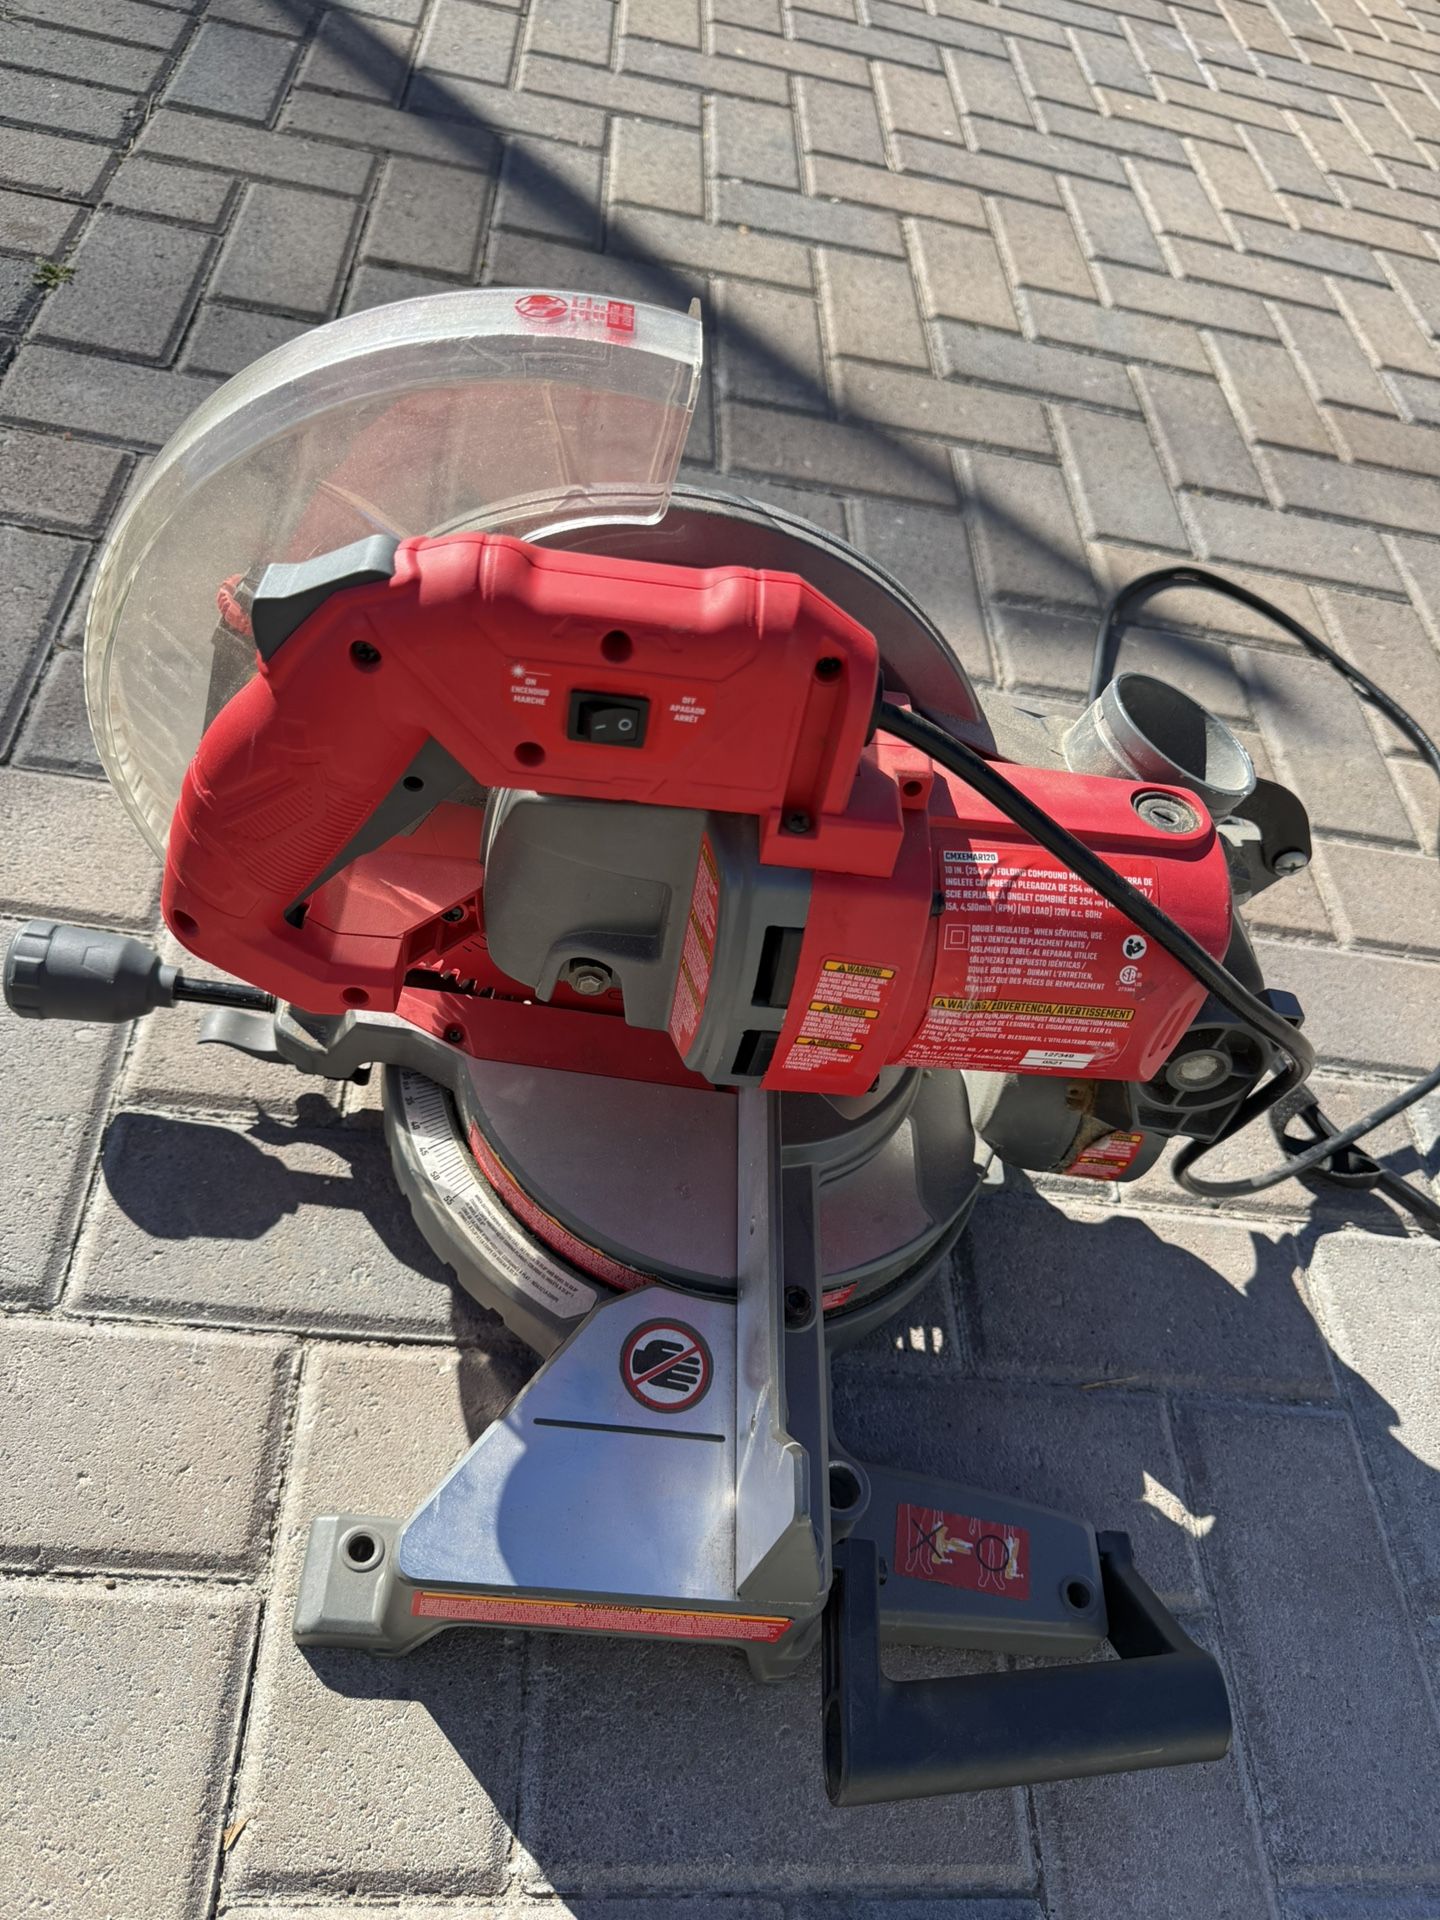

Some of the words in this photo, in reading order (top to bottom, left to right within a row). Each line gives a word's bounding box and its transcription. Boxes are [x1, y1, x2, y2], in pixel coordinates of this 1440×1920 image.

[512, 686, 550, 696] ENCENDIDO
[513, 696, 546, 705] MARCHE
[670, 704, 706, 715] APAGADO
[945, 852, 996, 861] CMXEMAR120
[954, 866, 964, 874] IN.
[997, 868, 1026, 877] FOLDING
[1028, 870, 1067, 880] COMPOUND
[1144, 878, 1152, 886] DE
[946, 878, 974, 886] INGLETE
[976, 879, 1016, 888] COMPUESTA
[1018, 880, 1056, 890] PLEGADIZA
[1058, 883, 1067, 892] DE
[1069, 884, 1083, 893] 254
[946, 890, 962, 898] SCIE
[963, 890, 999, 900] REPLIABLE
[1007, 892, 1034, 901] ONGLET
[1035, 892, 1066, 903] COMBINÉ
[1069, 896, 1078, 904] DE
[1080, 896, 1093, 906] 254
[946, 903, 959, 912] 15A,
[996, 904, 1016, 914] (RPM)
[1054, 907, 1070, 917] 120V
[1085, 910, 1102, 918] 60Hz
[1034, 928, 1054, 936] WHEN
[1054, 929, 1089, 940] SERVICING,
[1090, 932, 1103, 940] USE
[971, 935, 988, 943] ONLY
[1019, 937, 1064, 947] REPLACEMENT
[1064, 940, 1086, 949] PARTS
[1042, 950, 1072, 959] REPARAR,
[1074, 952, 1098, 960] UTILICE
[1006, 957, 1014, 965] DE
[1015, 958, 1047, 967] REPUESTO
[1048, 958, 1081, 969] IDÉNTICAS
[848, 964, 882, 976] WARNING
[990, 966, 1022, 975] ISOLATION
[1027, 968, 1052, 977] DURANT
[1022, 978, 1044, 986] PIÈCES
[1045, 979, 1054, 987] DE
[1054, 980, 1105, 990] REMPLACEMENT
[1065, 1017, 1103, 1026] INSTRUCTION
[1046, 1024, 1072, 1032] USUARIO
[405, 1096, 414, 1106] 35
[411, 1121, 420, 1130] 40
[419, 1147, 430, 1156] 45
[430, 1171, 440, 1181] 50
[444, 1195, 454, 1206] 55
